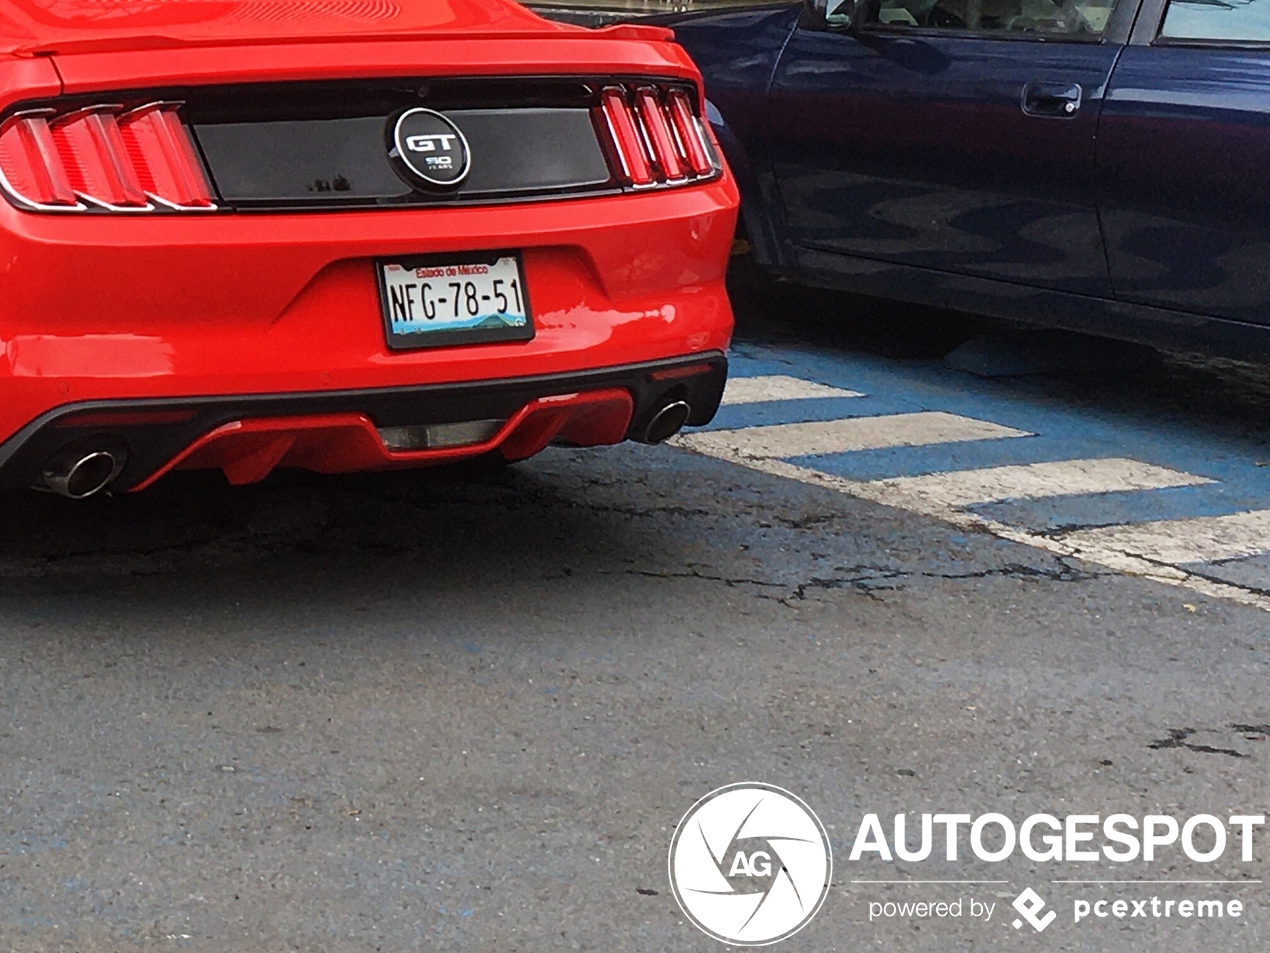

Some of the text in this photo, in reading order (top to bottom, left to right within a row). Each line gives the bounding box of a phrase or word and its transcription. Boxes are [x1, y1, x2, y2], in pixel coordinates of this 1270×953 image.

[405, 134, 456, 152] GT
[415, 266, 445, 279] Estado
[446, 265, 457, 277] de
[390, 278, 522, 322] NFG-78-51
